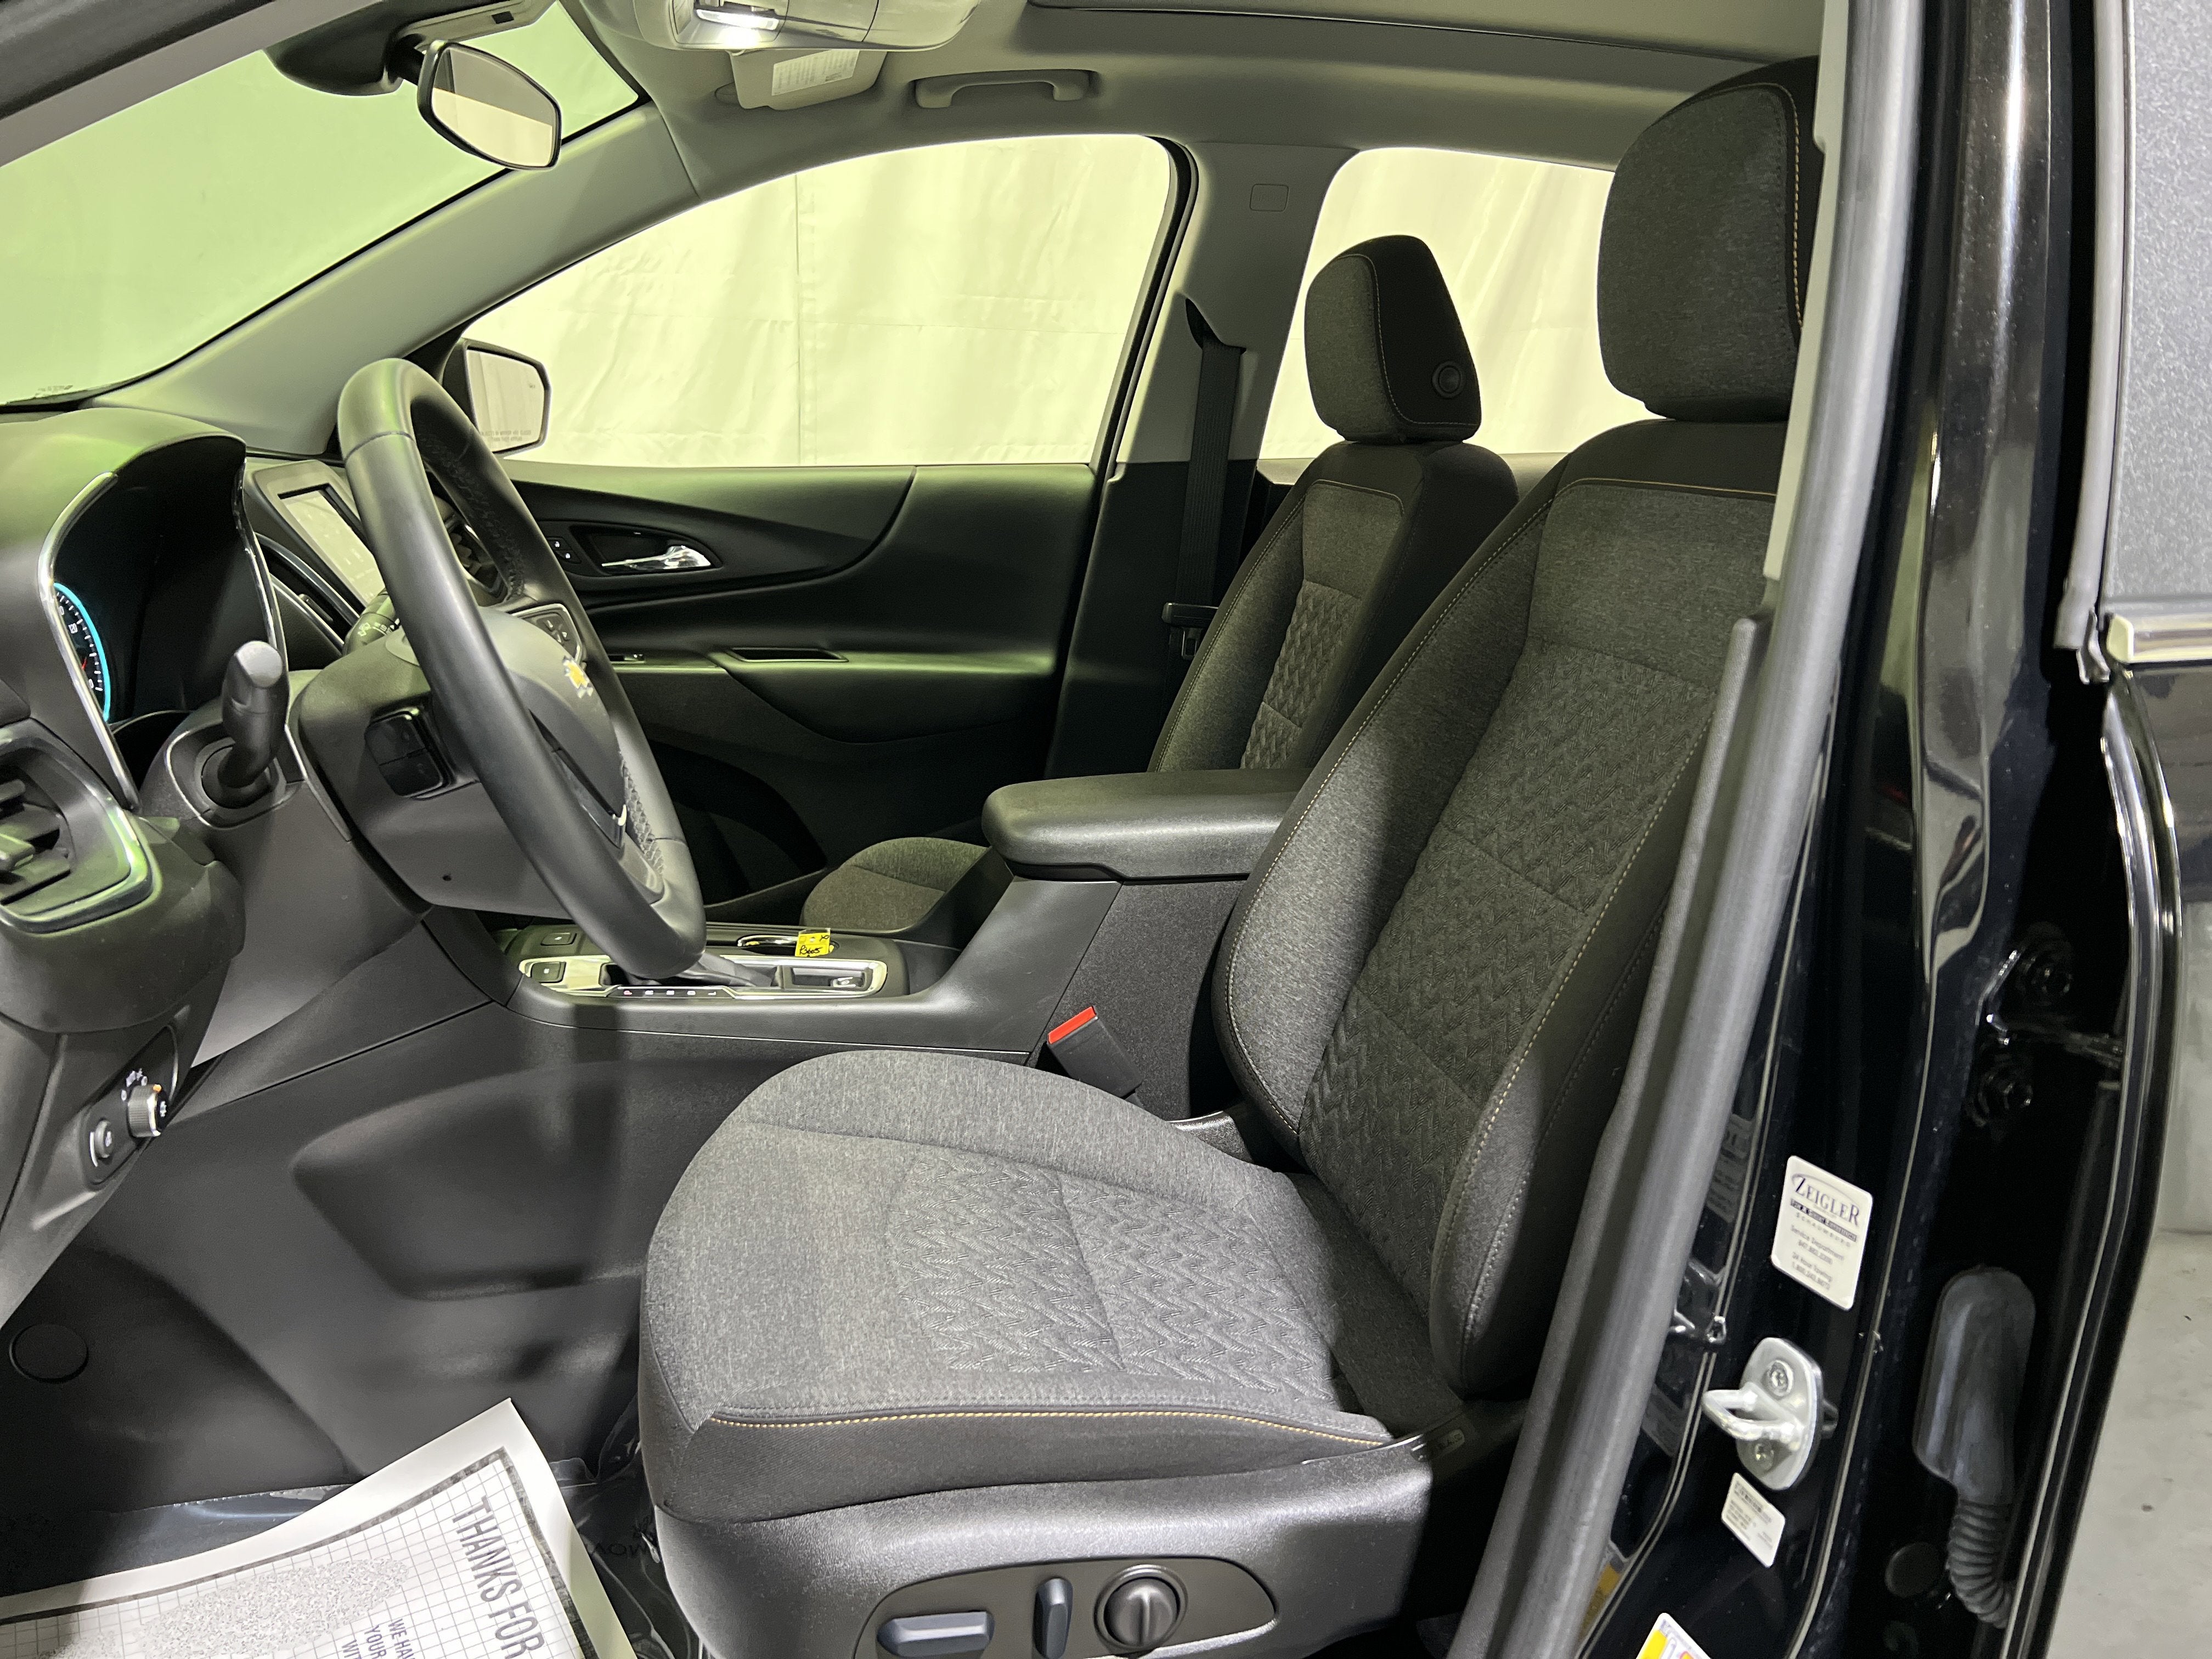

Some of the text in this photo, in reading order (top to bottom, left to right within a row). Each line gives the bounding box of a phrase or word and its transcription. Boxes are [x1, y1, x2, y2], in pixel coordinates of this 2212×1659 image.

[1794, 1177, 1859, 1226] ZEIGLER
[452, 1495, 545, 1659] THANKS FOR
[364, 1624, 387, 1659] YOUR
[388, 1618, 416, 1659] WE HAV
